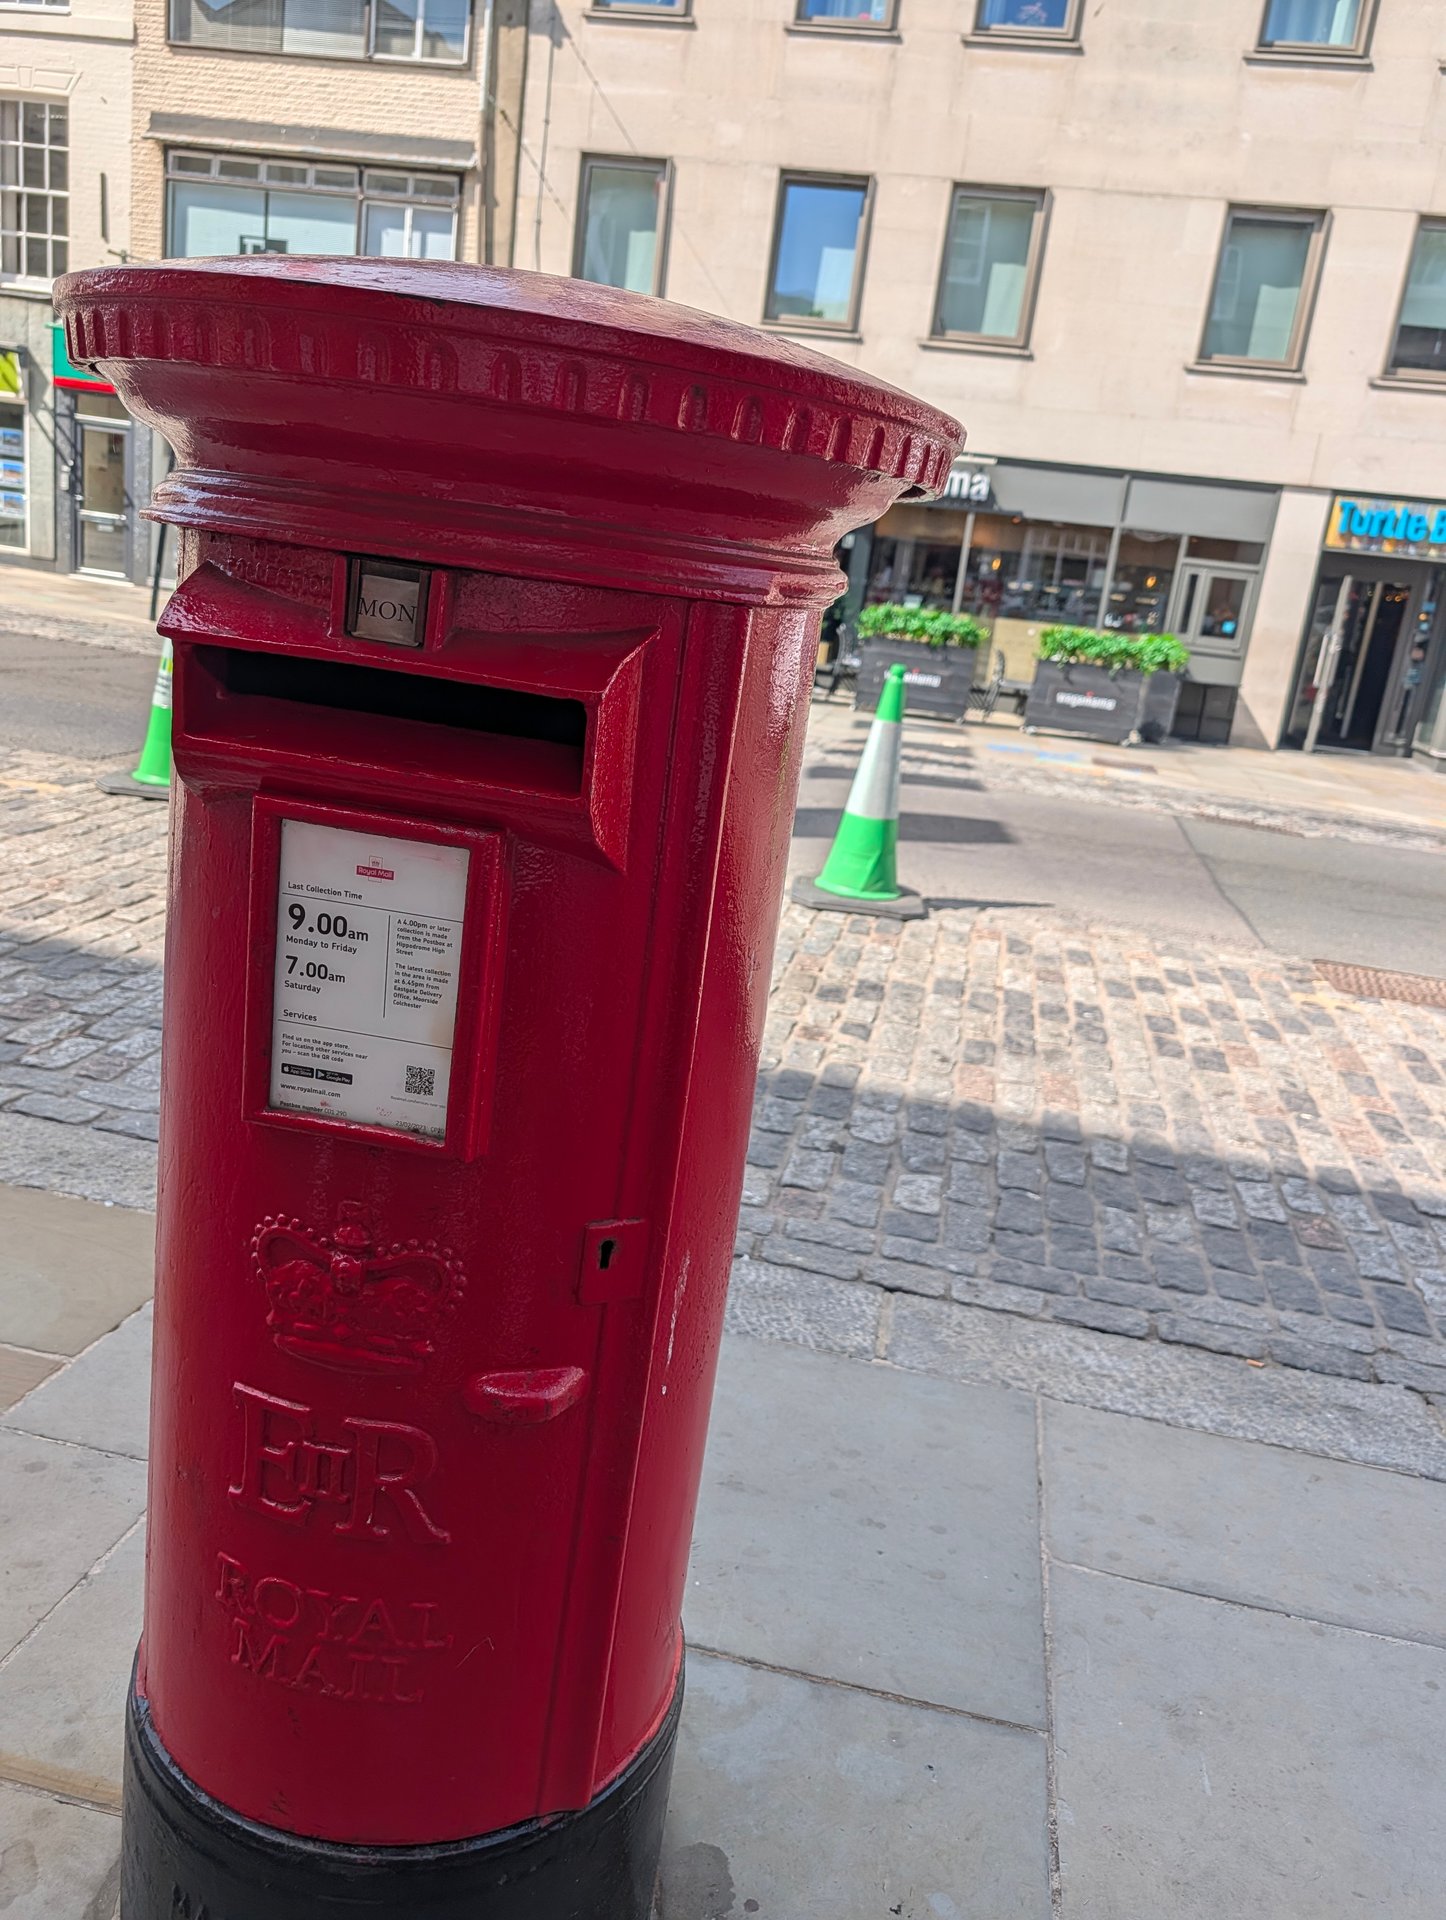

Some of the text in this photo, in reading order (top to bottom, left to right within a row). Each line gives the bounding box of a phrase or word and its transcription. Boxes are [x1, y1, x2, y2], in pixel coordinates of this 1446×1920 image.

[1337, 501, 1428, 542] Turtle
[357, 597, 418, 624] MON
[358, 866, 393, 878] Royal Mail
[288, 881, 363, 900] Last Collection Time
[288, 903, 369, 941] 9.00am
[403, 919, 428, 929] 4.00pm
[397, 927, 424, 936] collection
[286, 935, 358, 955] Monday to Friday
[396, 941, 446, 955] Hippodrome High
[423, 938, 446, 947] Postbox
[395, 948, 413, 956] Street
[285, 955, 346, 983] 7.00am
[395, 962, 452, 977] The latest collection
[284, 980, 321, 994] Saturday
[402, 979, 425, 988] 6.45pm
[433, 977, 449, 985] made
[393, 985, 442, 999] Eastgate Delivery
[393, 1000, 422, 1009] Colchester
[413, 995, 439, 1005] Moorside
[283, 1009, 317, 1021] Services
[282, 1033, 294, 1041] Find
[292, 1042, 314, 1052] locating
[331, 1049, 354, 1058] services
[280, 1083, 341, 1098] www.royalmail.com
[279, 1100, 301, 1109] Postbox
[302, 1105, 323, 1113] number
[215, 1551, 453, 1649] ROYAL
[230, 1617, 425, 1703] MAIL
